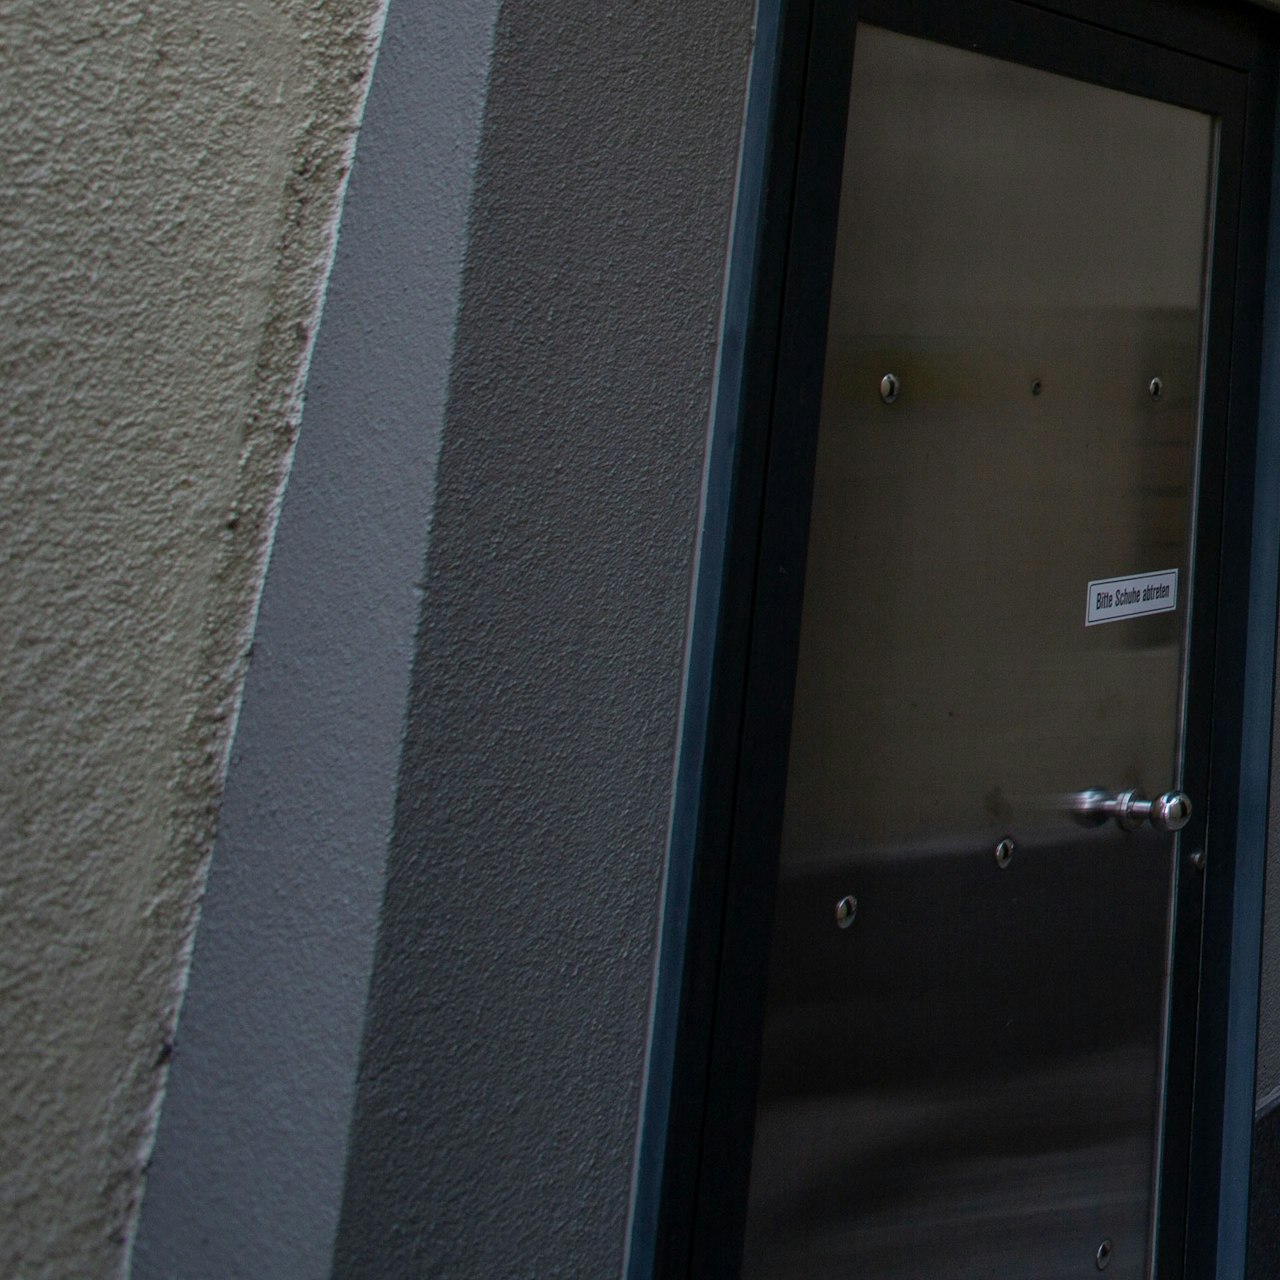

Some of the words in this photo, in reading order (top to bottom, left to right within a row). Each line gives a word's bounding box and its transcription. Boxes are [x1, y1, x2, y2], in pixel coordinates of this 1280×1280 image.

[1096, 592, 1113, 609] Bitte
[1115, 587, 1141, 607] Schuhe
[1142, 583, 1170, 602] abtreten
